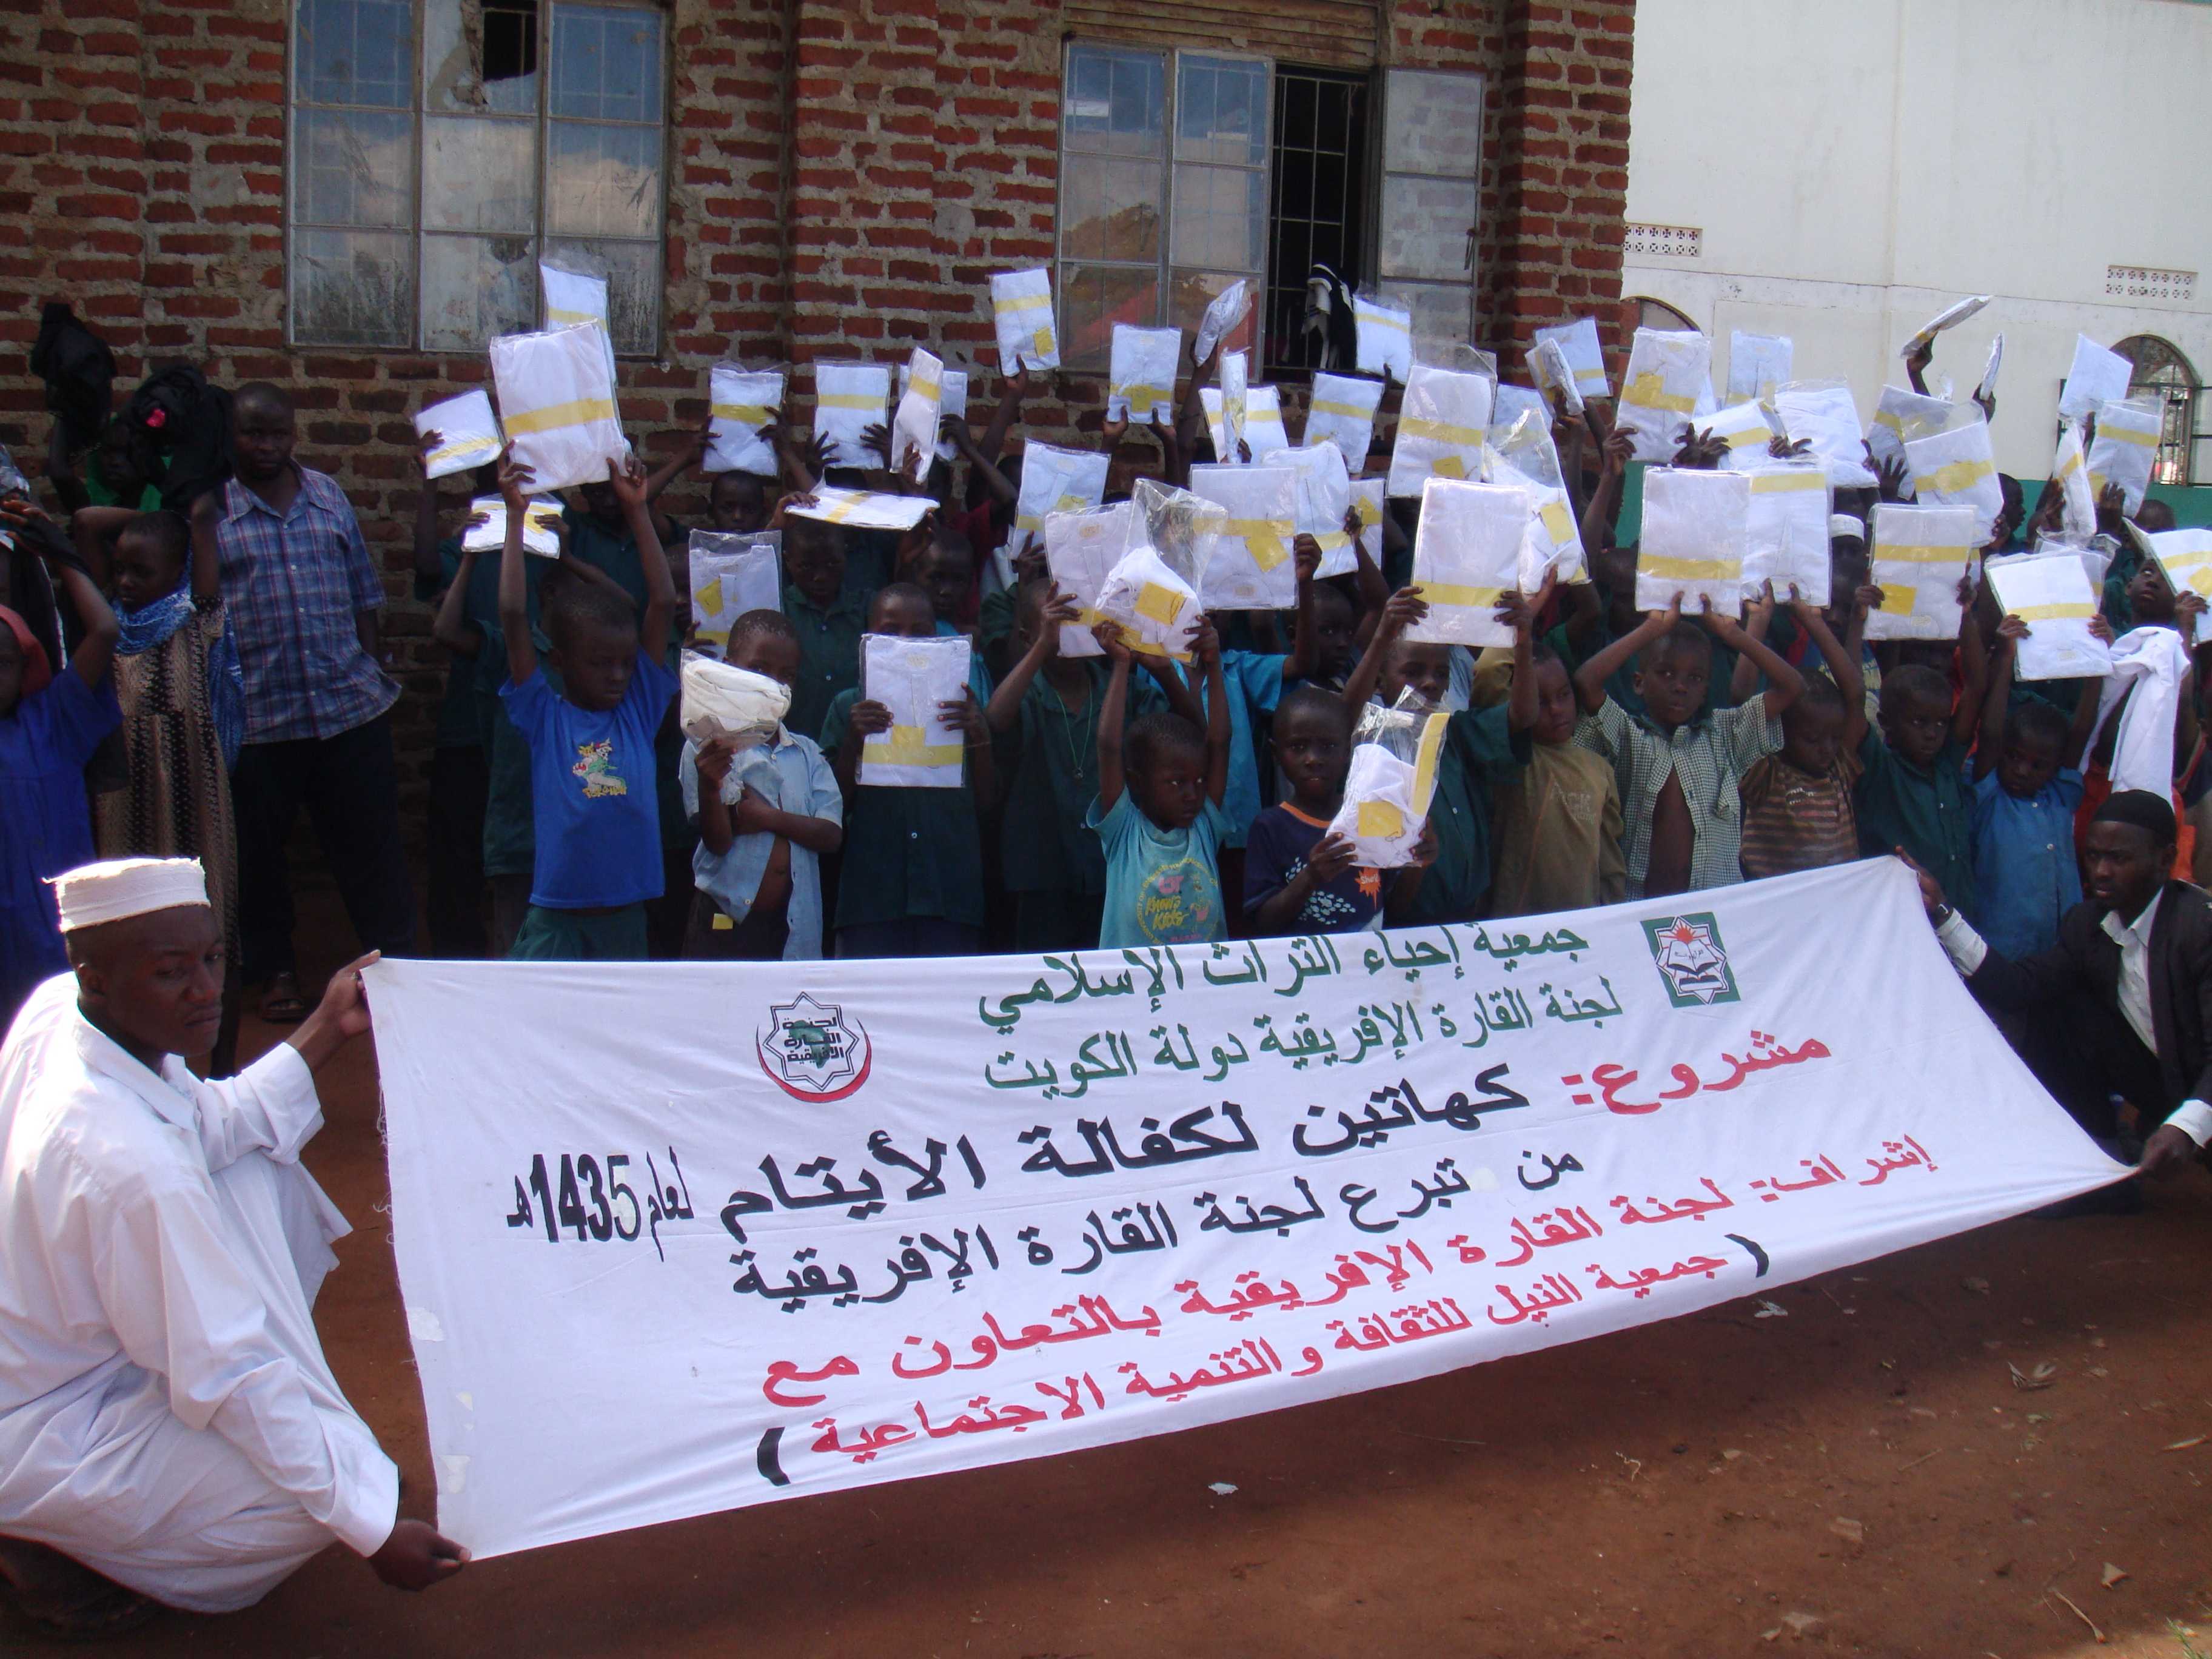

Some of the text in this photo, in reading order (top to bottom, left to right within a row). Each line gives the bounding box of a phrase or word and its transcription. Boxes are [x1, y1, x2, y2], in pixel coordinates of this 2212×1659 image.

[782, 1016, 837, 1030] لجنة
[979, 922, 1590, 1036] جمعية إحياء التراث الإسلامي
[985, 976, 1623, 1101] لجنة القارة الإفريقية دولة الكويت
[1561, 1030, 1831, 1115] مشروع:
[1017, 1101, 1259, 1178] لكفالة
[1293, 1062, 1530, 1156] كهاتين
[646, 1145, 694, 1263] لعام
[720, 1129, 987, 1245] الأيتام
[729, 1150, 1584, 1314] من تبرع لجنة القارة الإفريقية
[763, 1134, 1938, 1407] إشراف: لجنة القارة الإفريقية بالتعاون مع
[1326, 1298, 1472, 1352] للثقافة
[1488, 1272, 1583, 1326] النيل
[1118, 1336, 1282, 1402] التنمية
[1291, 1346, 1324, 1377] و
